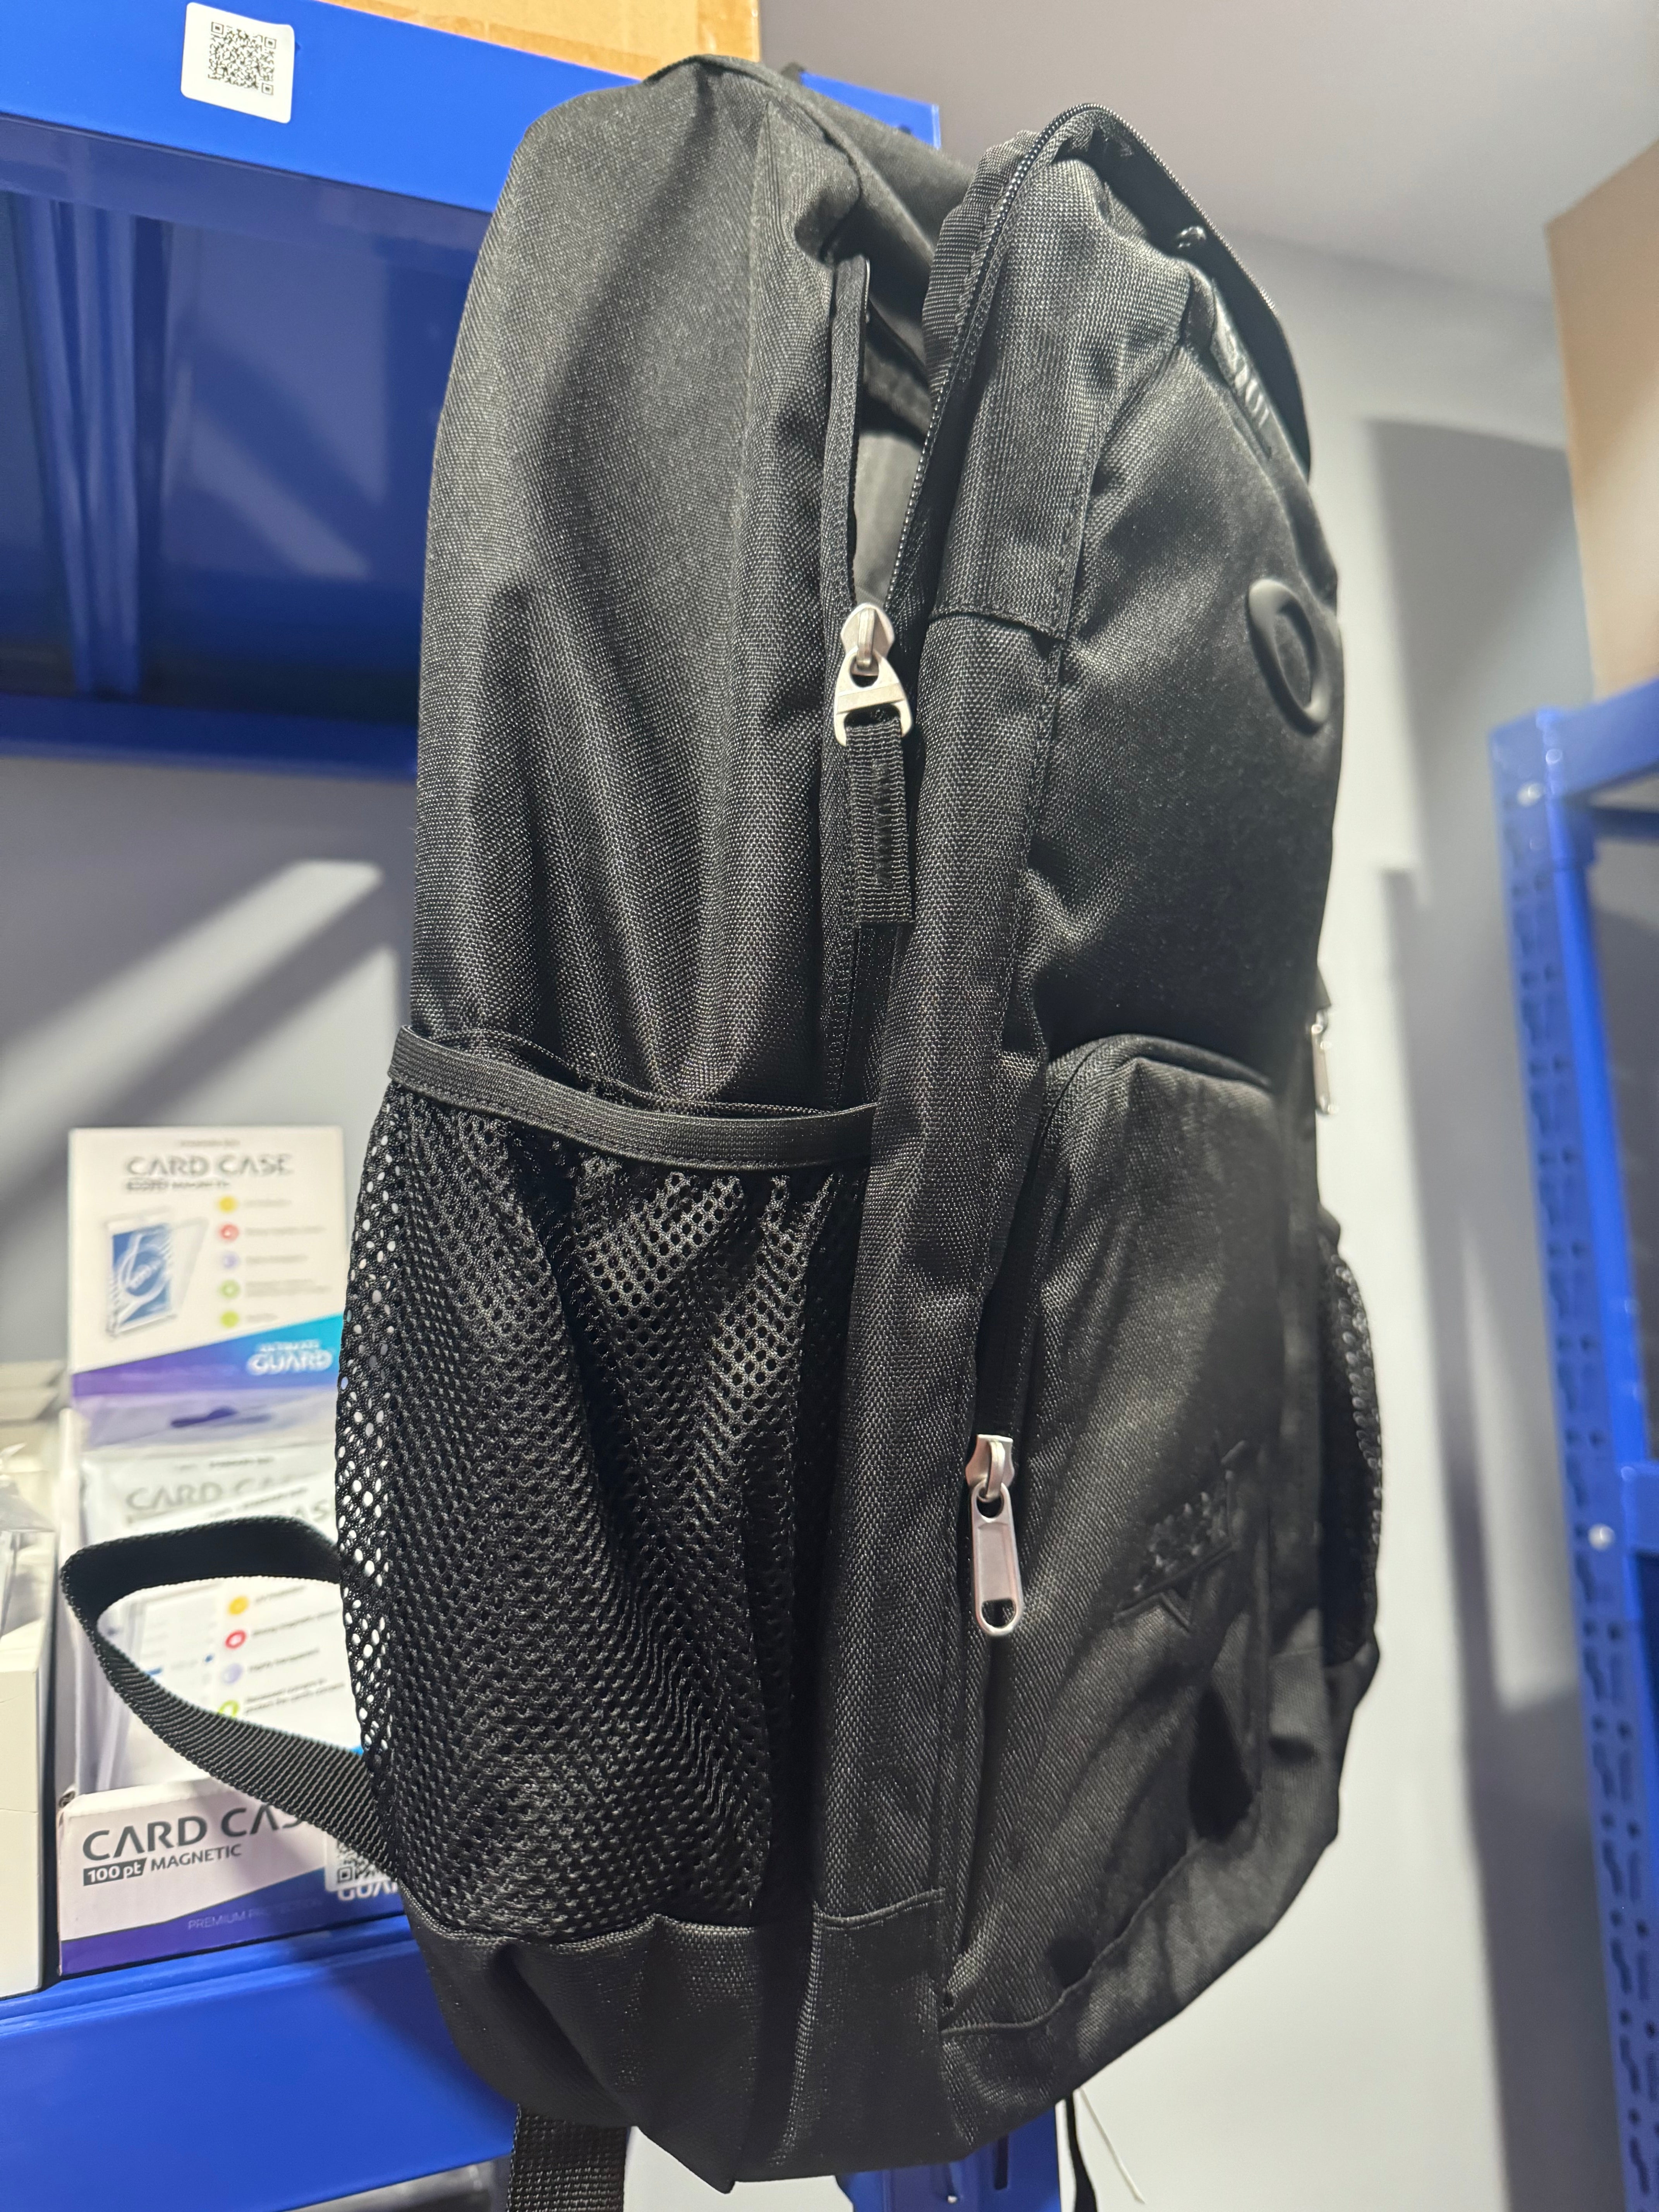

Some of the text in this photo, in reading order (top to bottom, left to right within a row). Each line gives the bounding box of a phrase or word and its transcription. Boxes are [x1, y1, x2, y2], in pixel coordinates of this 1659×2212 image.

[127, 1153, 294, 1176] CARD CASE
[247, 1349, 332, 1375] GUARD
[126, 1482, 222, 1510] CARD
[82, 1804, 302, 1861] CARD CA
[150, 1843, 242, 1872] MAGNETIC
[187, 1911, 246, 1930] PREMIUM
